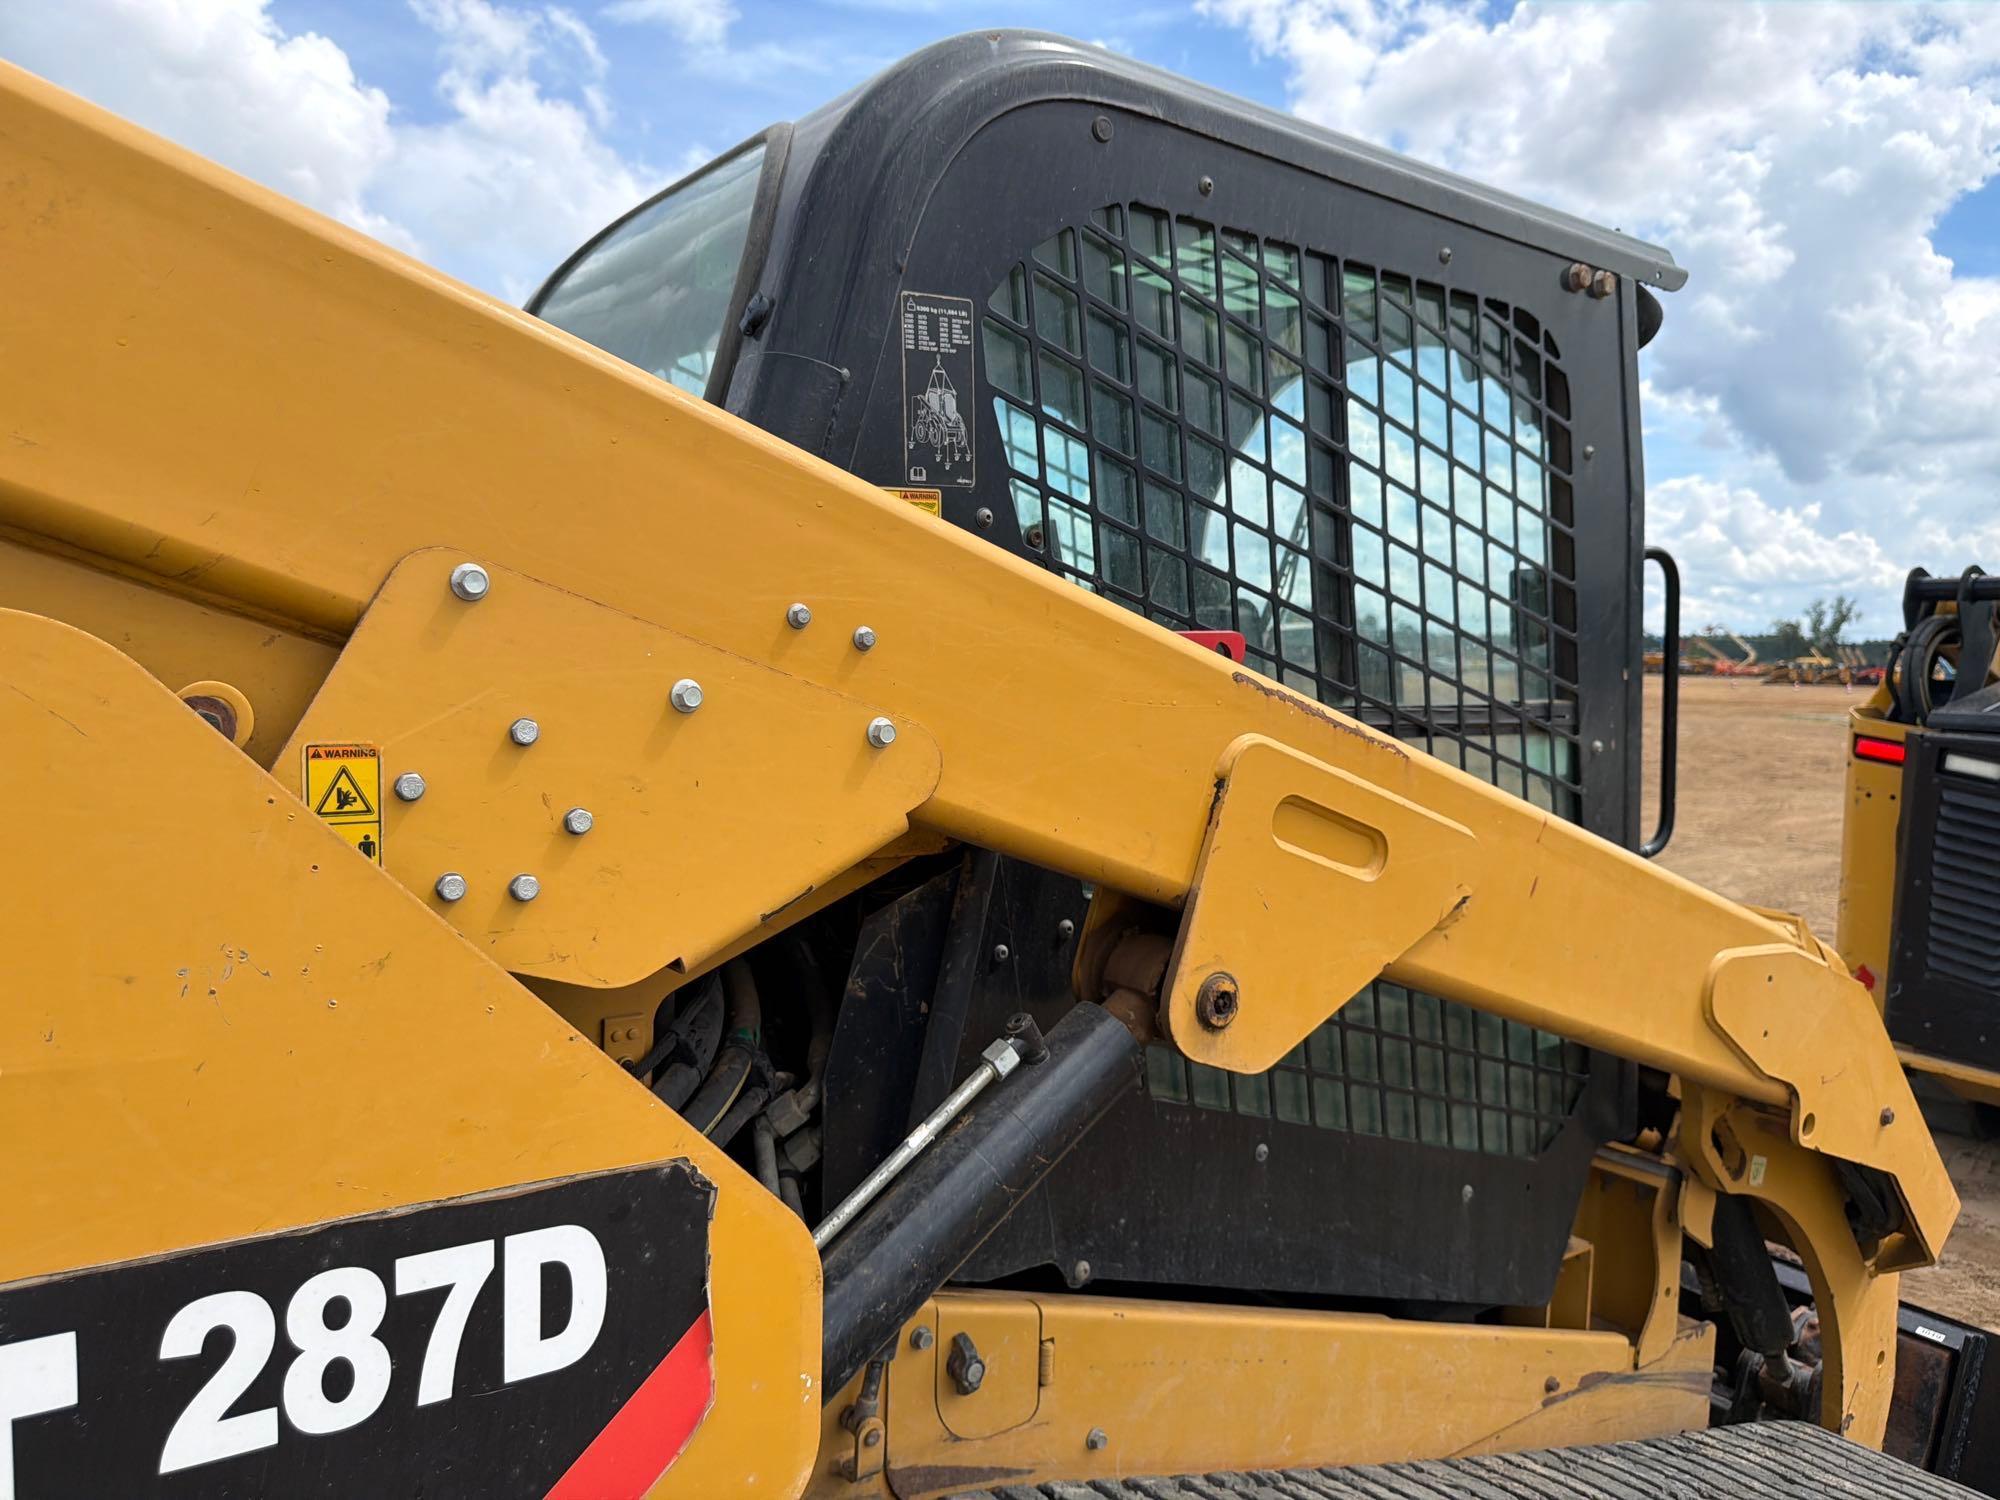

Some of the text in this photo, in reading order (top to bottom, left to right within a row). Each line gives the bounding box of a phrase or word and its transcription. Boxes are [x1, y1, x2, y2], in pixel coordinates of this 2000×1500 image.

[910, 492, 937, 500] WARNING
[324, 749, 377, 758] WARNING
[159, 1224, 608, 1475] 287D
